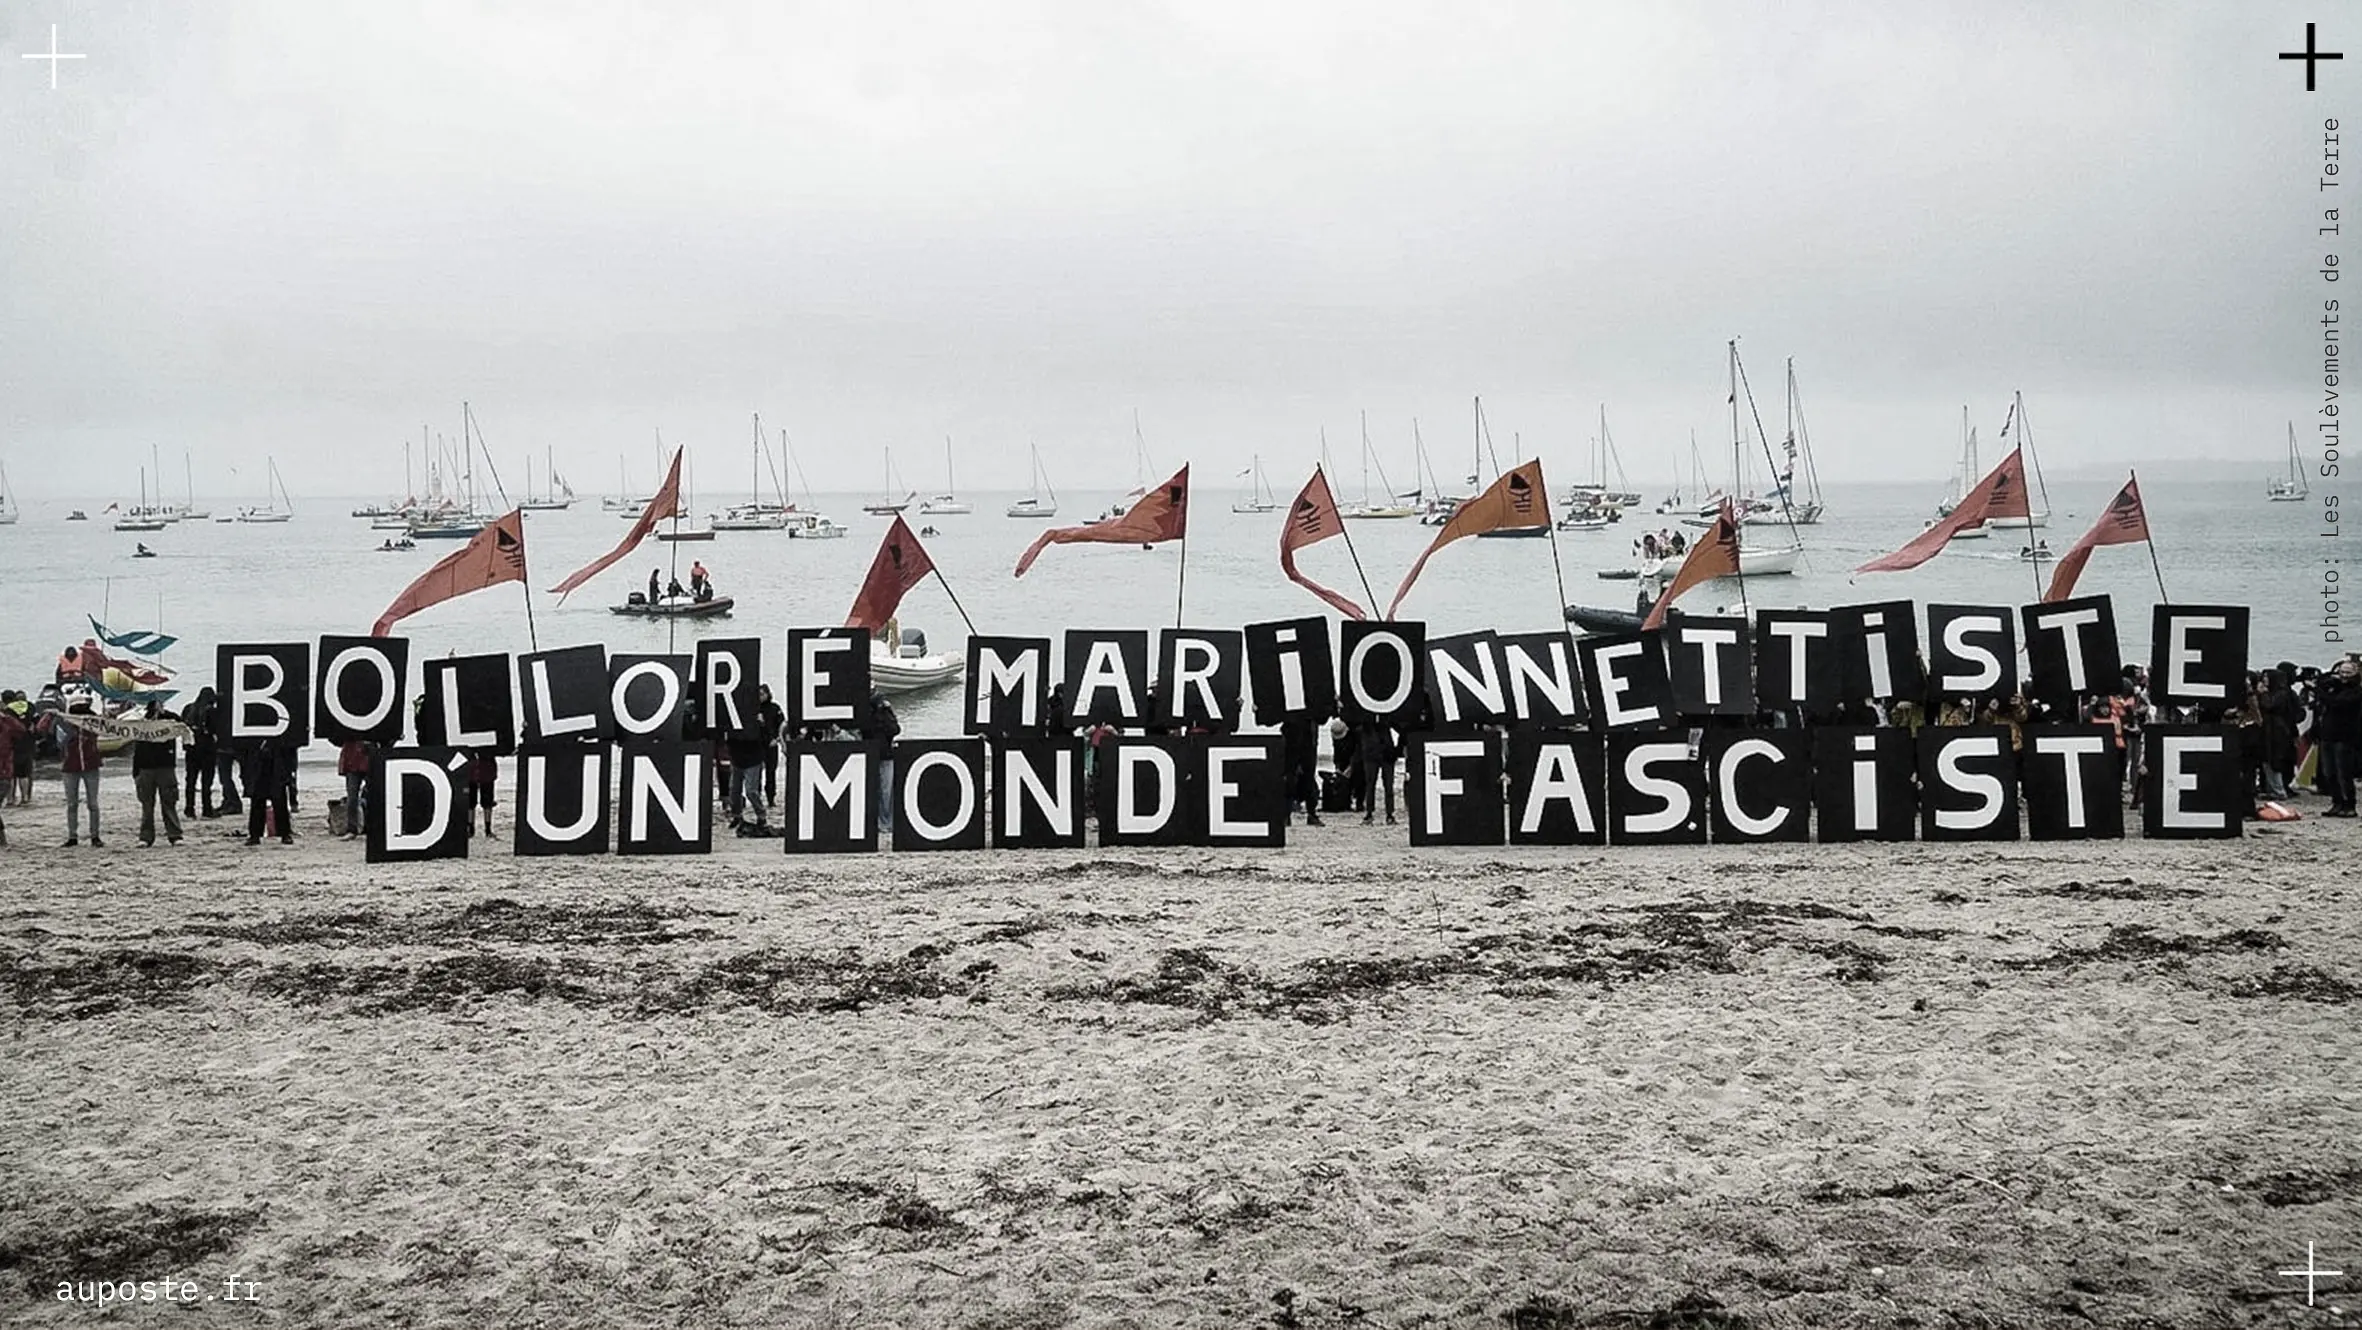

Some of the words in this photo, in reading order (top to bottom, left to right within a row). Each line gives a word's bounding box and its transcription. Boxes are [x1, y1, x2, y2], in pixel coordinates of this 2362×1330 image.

[232, 628, 854, 747] BOLLORÉ
[385, 751, 700, 851] D'UN
[798, 746, 1270, 842] MONDE
